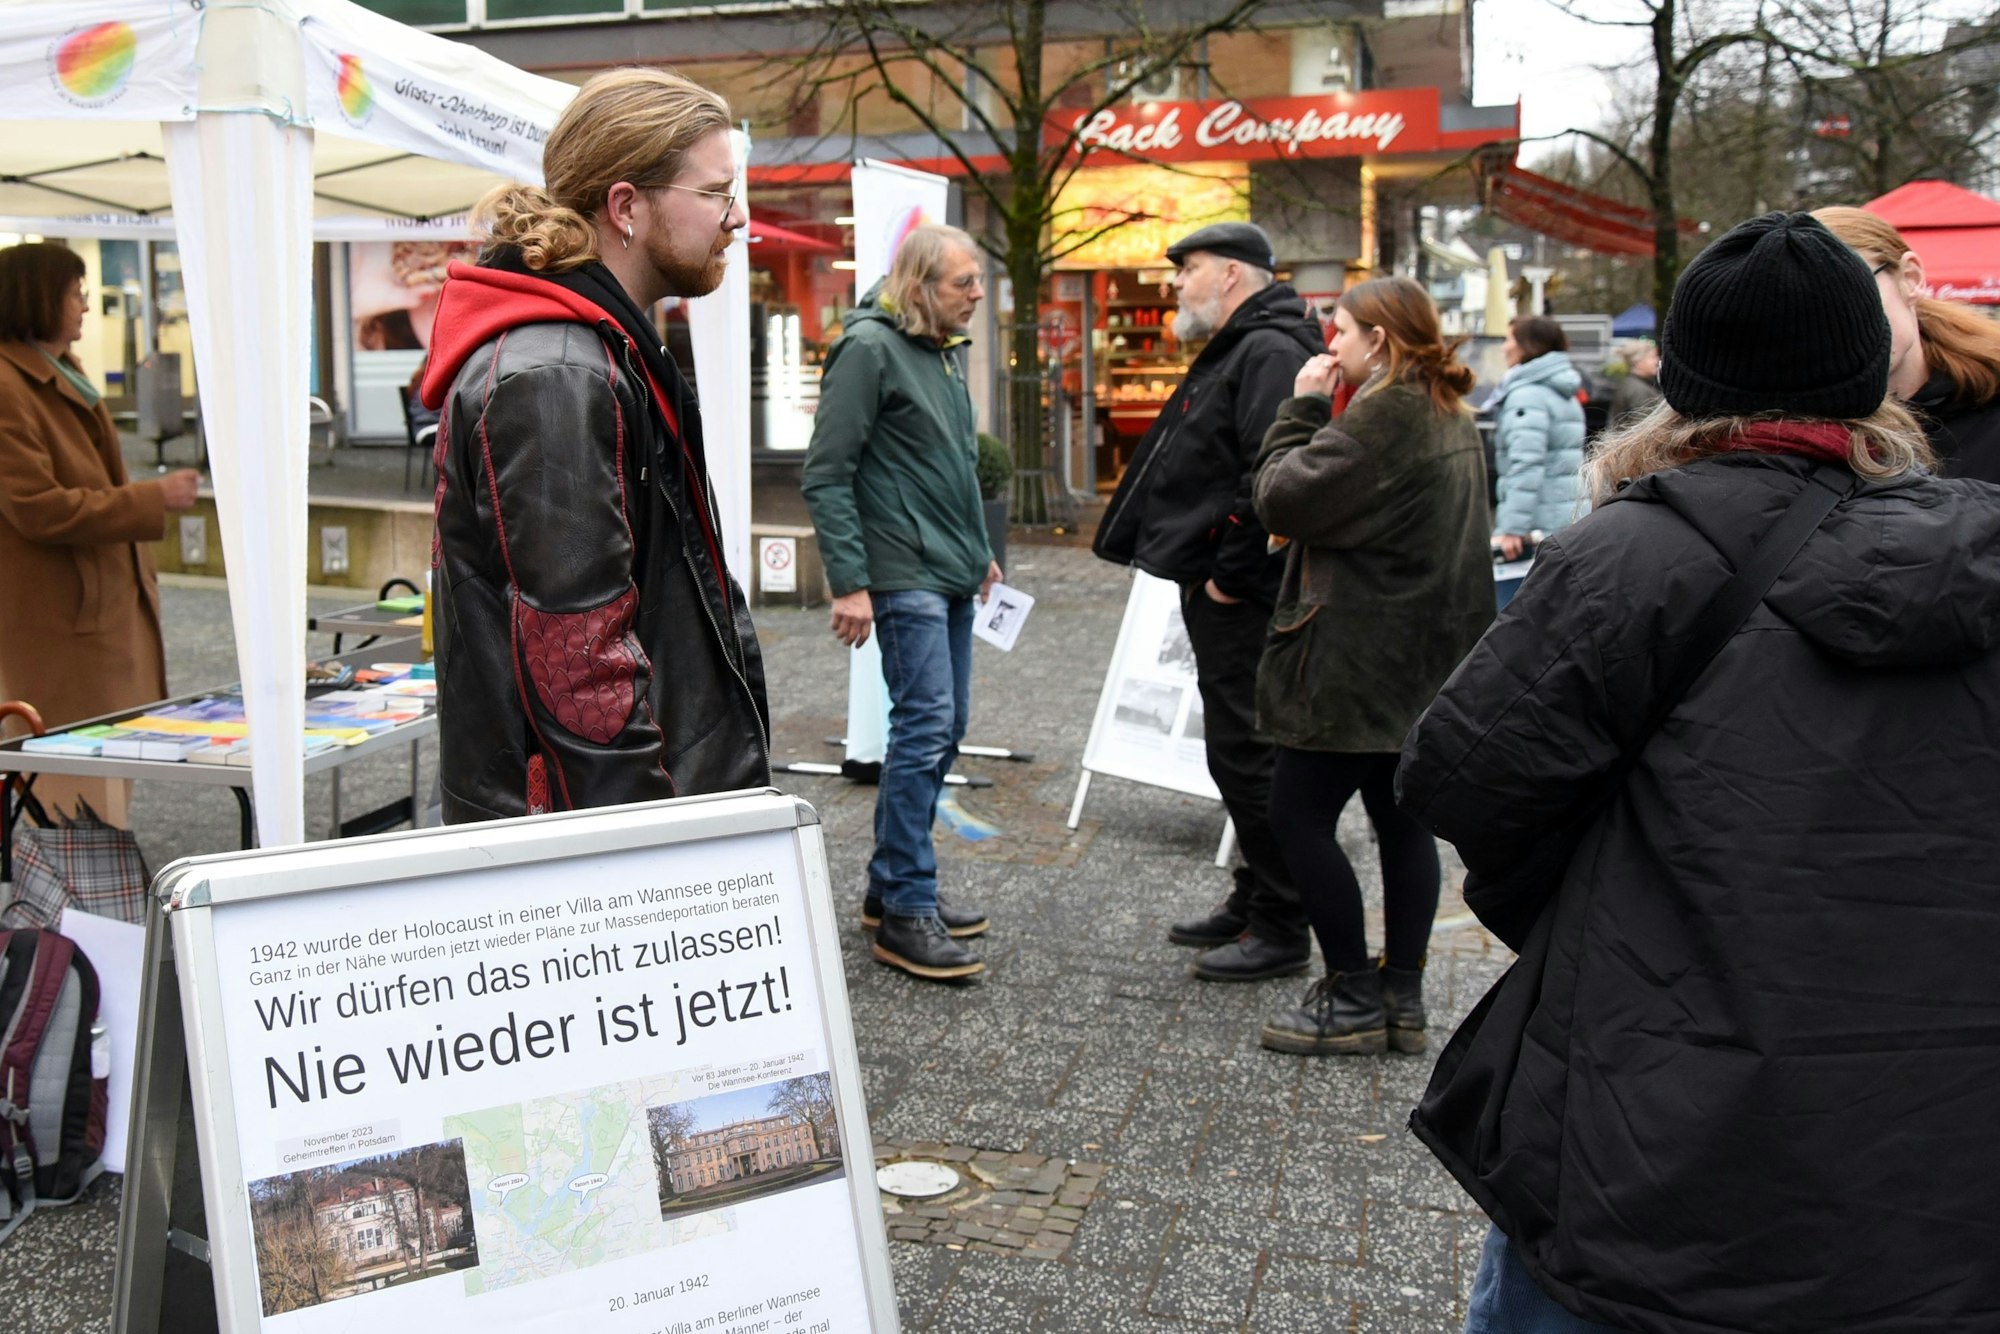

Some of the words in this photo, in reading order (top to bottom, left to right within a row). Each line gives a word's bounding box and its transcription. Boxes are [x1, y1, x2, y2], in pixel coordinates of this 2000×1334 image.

[1074, 107, 1183, 153] Back
[1195, 101, 1404, 154] Company
[250, 940, 297, 963] 1942
[303, 932, 361, 955] wurde
[368, 928, 397, 945] der
[403, 913, 493, 940] Holocaust
[498, 909, 513, 925] in
[519, 904, 561, 922] einer
[566, 896, 603, 914] Villa
[608, 894, 632, 909] am
[636, 882, 712, 904] Wannsee
[717, 871, 774, 898] geplant
[249, 969, 291, 985] Ganz
[297, 964, 310, 978] in
[316, 960, 340, 975] der
[345, 953, 386, 970] Nähe
[390, 944, 445, 963] wurden
[450, 938, 480, 958] jetzt
[483, 931, 530, 949] wieder
[535, 925, 574, 940] Pläne
[579, 921, 600, 934] zur
[604, 900, 728, 929] Massendeportation
[731, 893, 779, 909] beraten
[254, 990, 321, 1031] Wir
[336, 973, 453, 1018] dürfen
[467, 961, 530, 996] das
[542, 943, 623, 983] nicht
[632, 915, 781, 968] zulassen!
[264, 1045, 365, 1108] Nie
[386, 1011, 574, 1084] wieder
[595, 993, 658, 1045] ist
[673, 965, 791, 1045] jetzt!
[691, 1074, 704, 1083] Vor
[705, 1071, 715, 1080] 83
[717, 1066, 741, 1078] Jahren
[749, 1062, 761, 1071] 20.
[762, 1058, 785, 1070] Januar
[787, 1053, 805, 1063] 1942
[707, 1081, 720, 1091] Die
[722, 1067, 792, 1087] Wannsee-Konferenz
[283, 1143, 346, 1163] Geheimtreffen
[348, 1142, 356, 1150] in
[358, 1134, 395, 1148] Potsdam
[304, 1132, 349, 1147] November
[351, 1125, 374, 1138] 2023
[608, 1296, 628, 1311] 20.
[632, 1285, 674, 1305] Januar
[679, 1274, 709, 1293] 1942
[665, 1321, 692, 1334] Villa
[695, 1316, 715, 1330] am
[718, 1302, 763, 1324] Berliner
[766, 1287, 821, 1310] Wannsee
[725, 1319, 770, 1334] Männer
[784, 1309, 803, 1324] der
[810, 1318, 831, 1333] mal
